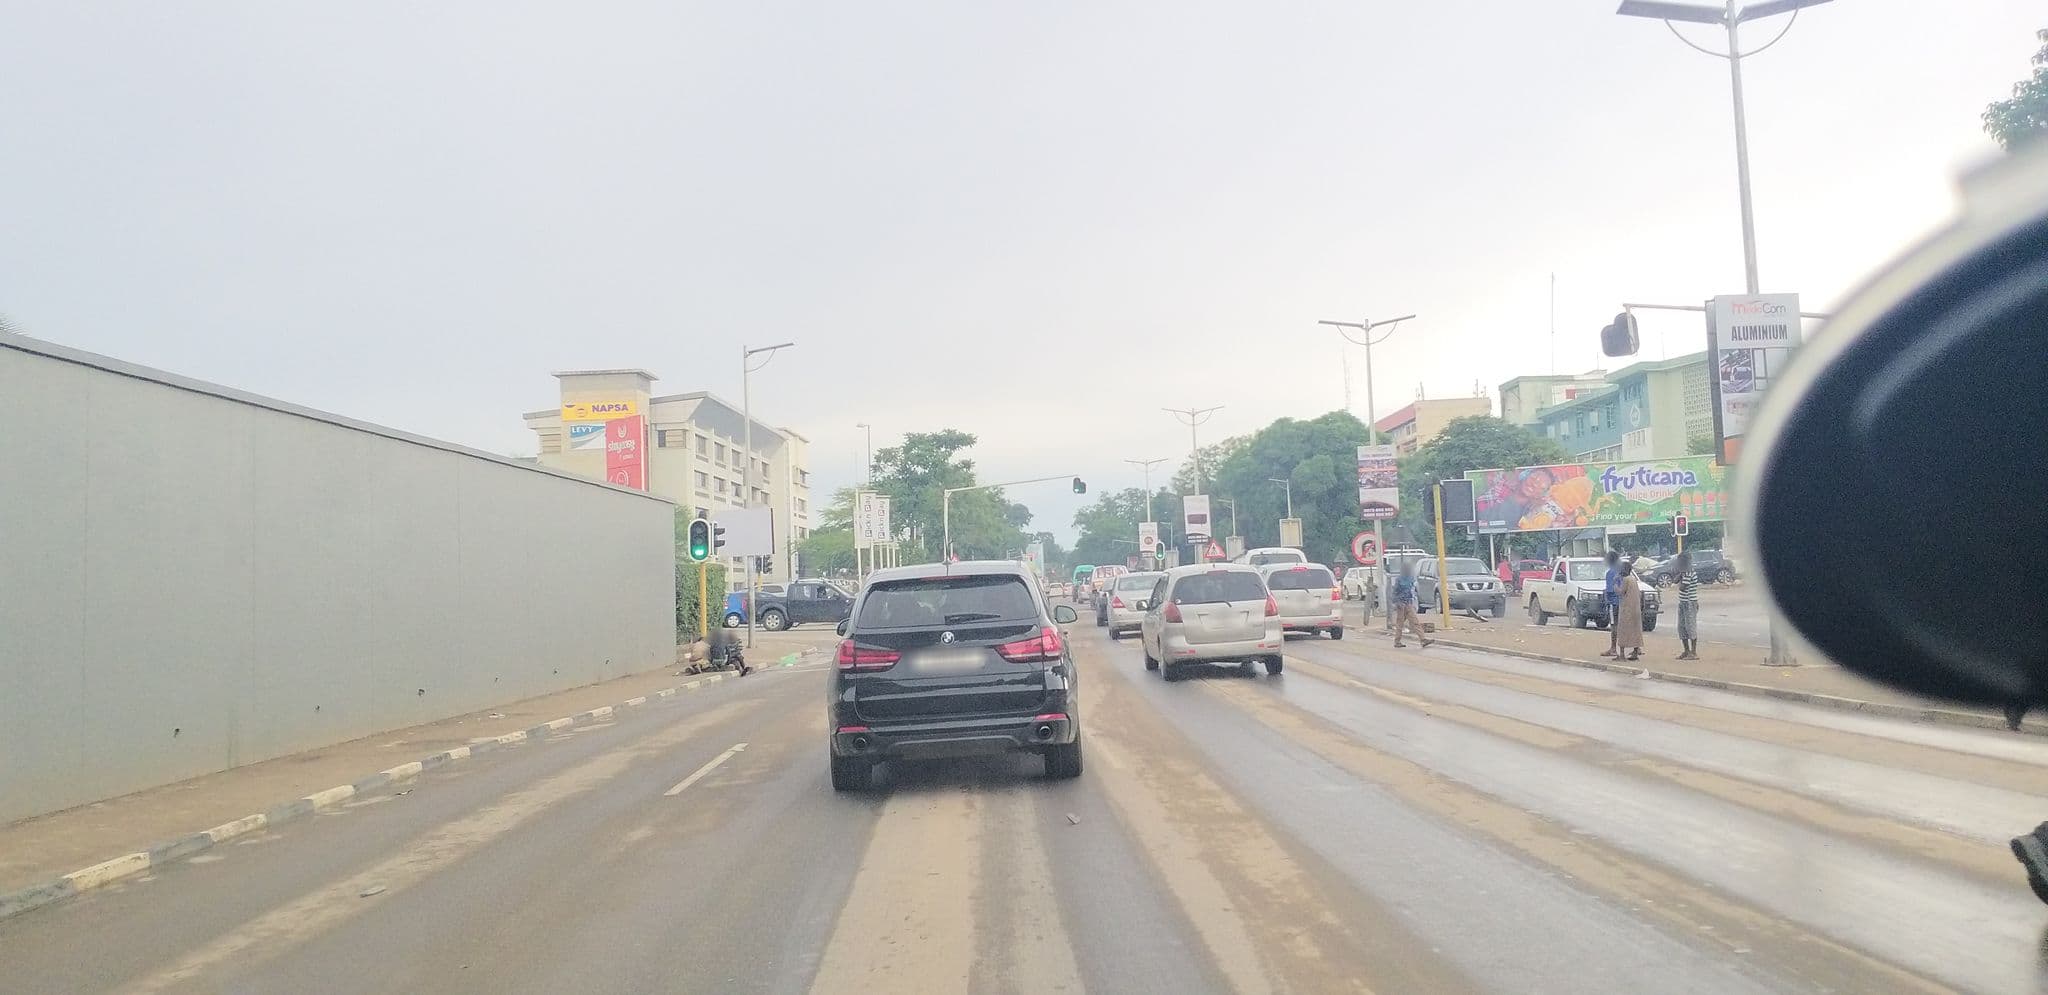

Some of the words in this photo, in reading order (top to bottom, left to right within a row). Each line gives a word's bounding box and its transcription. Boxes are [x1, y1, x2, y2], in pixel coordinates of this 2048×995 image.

[1731, 324, 1788, 341] ALUMINIUM
[591, 403, 629, 413] NAPSA
[1600, 465, 1697, 493] fruticana
[1614, 513, 1633, 521] your
